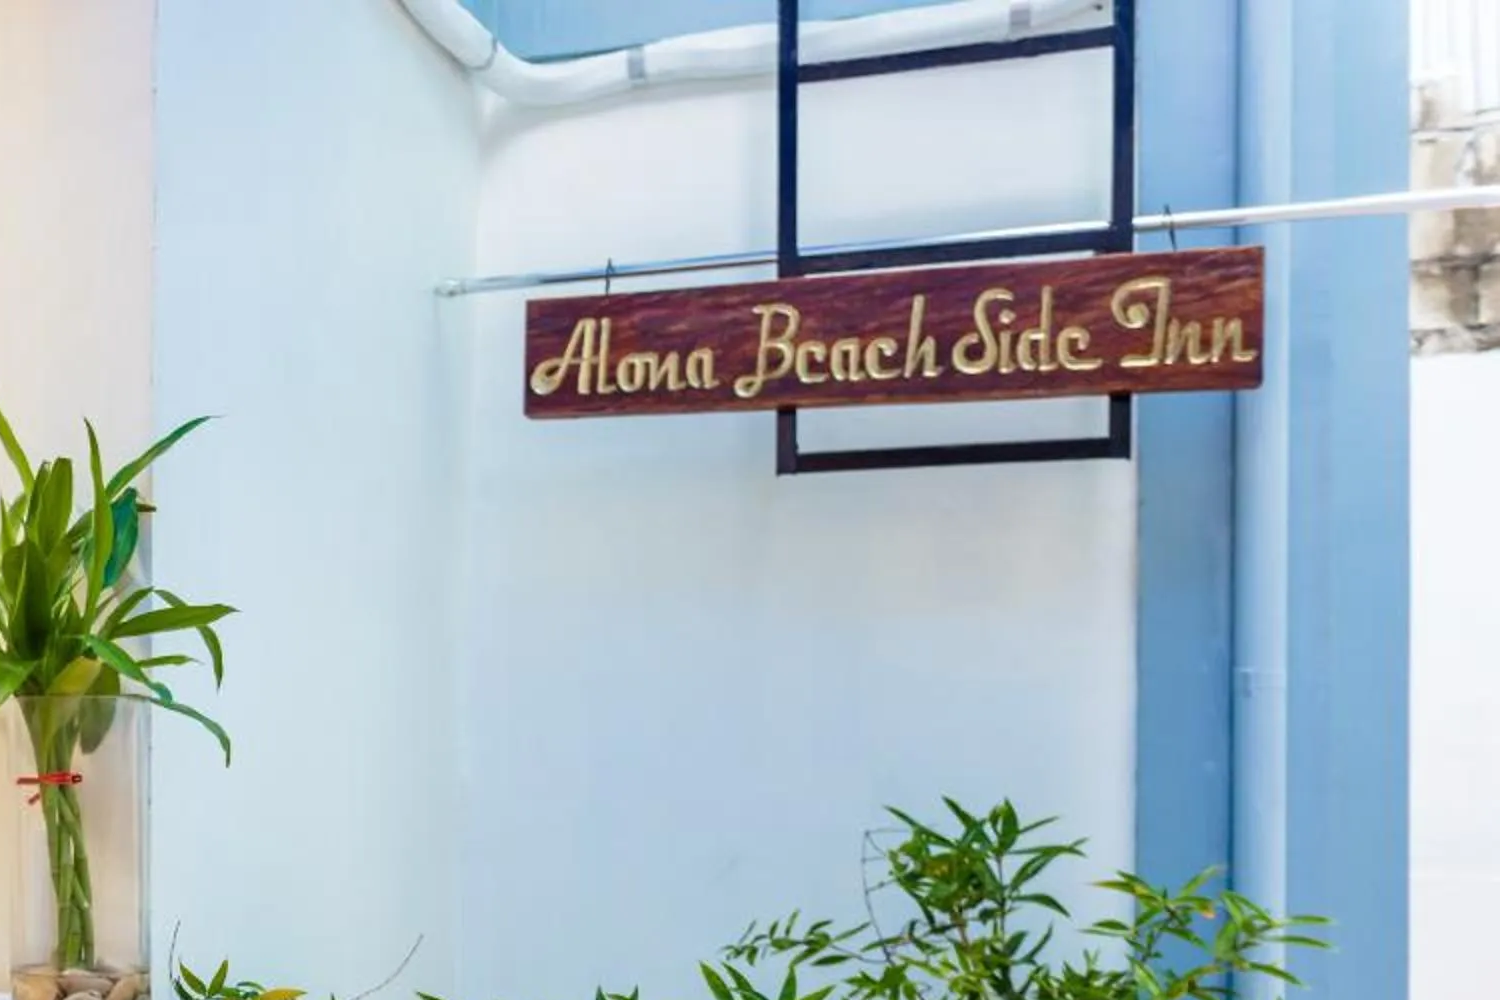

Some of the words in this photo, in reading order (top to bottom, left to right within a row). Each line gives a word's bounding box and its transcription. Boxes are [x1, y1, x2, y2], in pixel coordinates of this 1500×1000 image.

[530, 316, 719, 395] Alona
[734, 296, 943, 398] Beach
[951, 286, 1103, 375] Side
[1111, 276, 1258, 369] Inn
